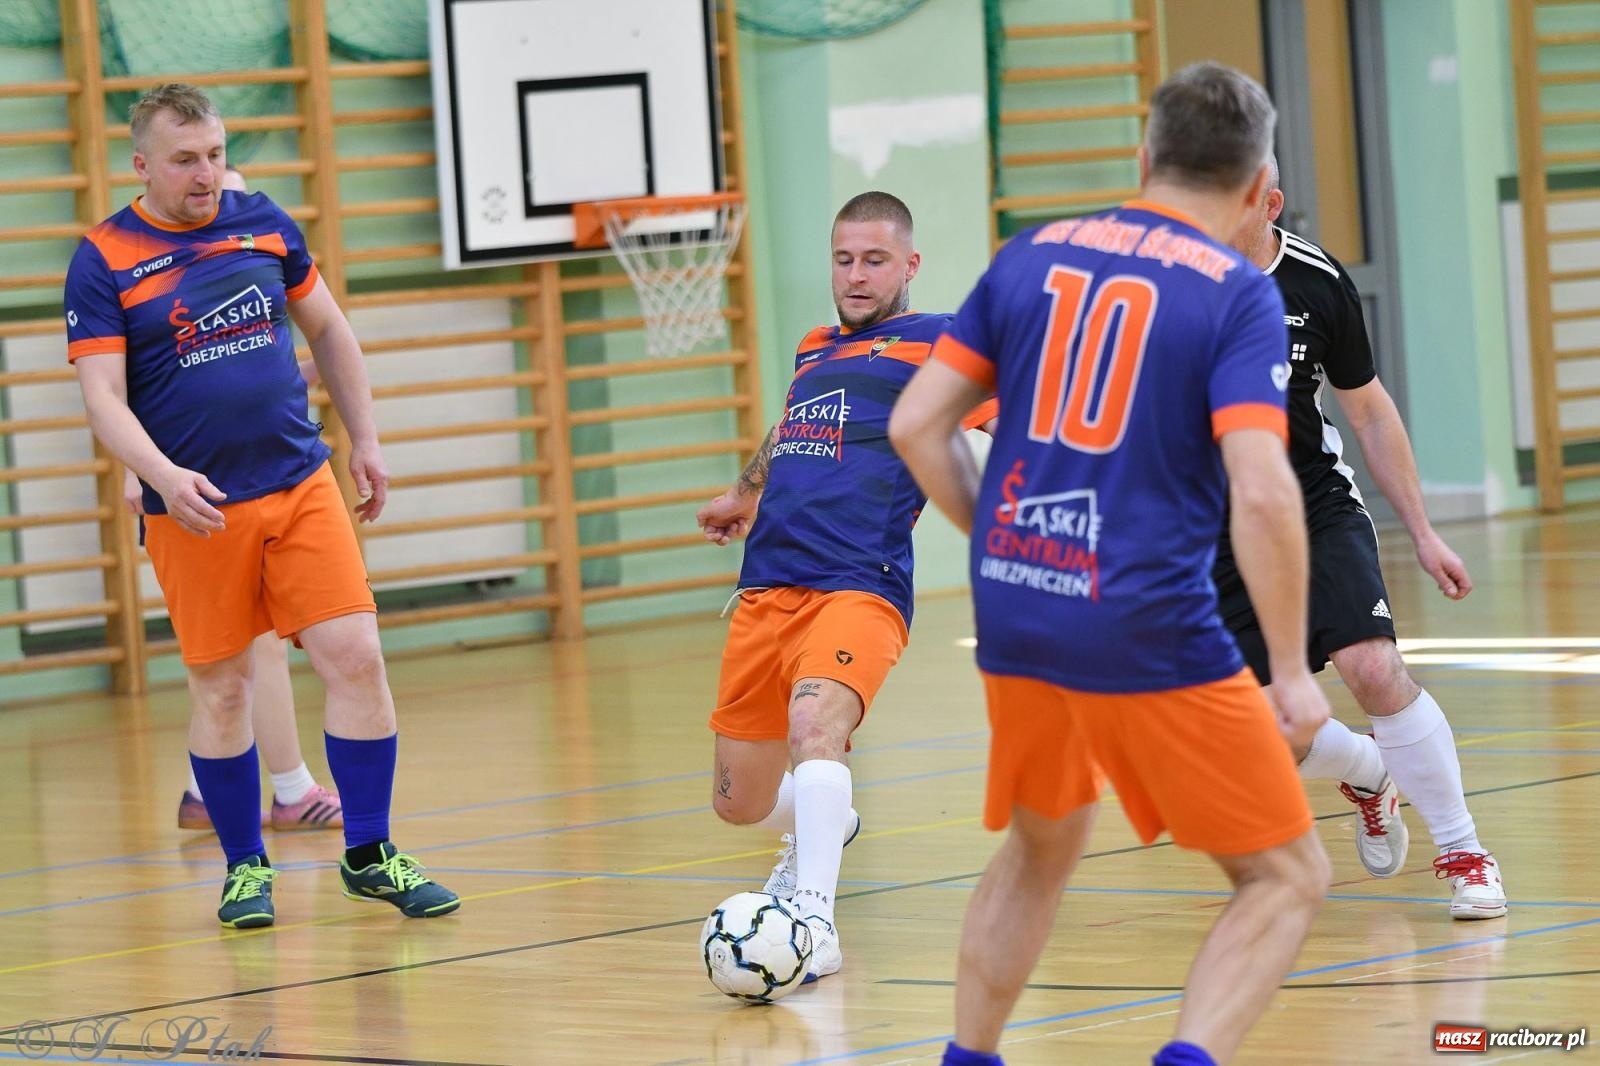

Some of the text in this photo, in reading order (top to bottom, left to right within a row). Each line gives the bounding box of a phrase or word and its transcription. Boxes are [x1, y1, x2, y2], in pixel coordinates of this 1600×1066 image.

[144, 256, 173, 273] VIGO
[179, 330, 272, 368] UBEZPIECZEŃ
[1027, 263, 1159, 455] 10
[771, 440, 837, 459] BEZPIECZEŃ
[778, 424, 843, 442] ENTRUM
[986, 527, 1098, 573] CENTRUM
[980, 556, 1091, 598] UBEZPIECZEŃ
